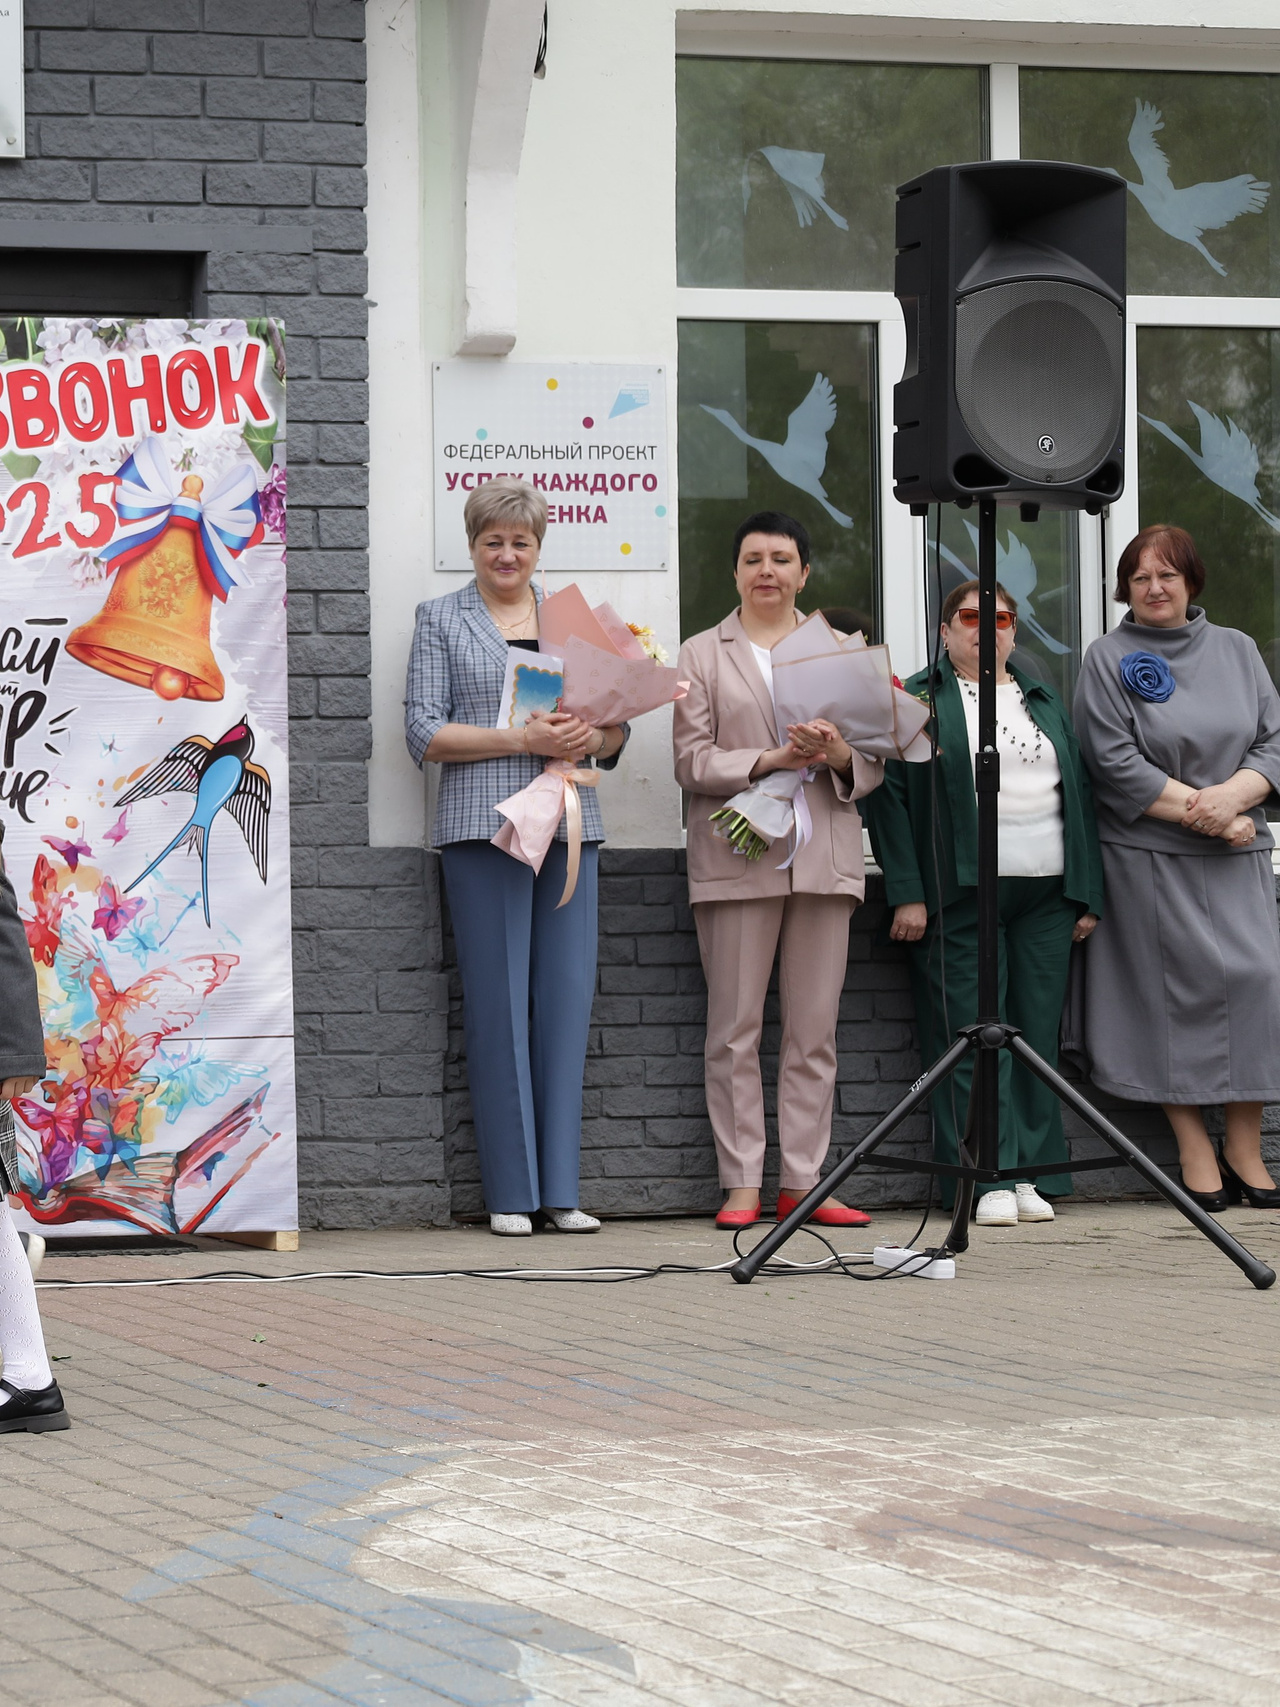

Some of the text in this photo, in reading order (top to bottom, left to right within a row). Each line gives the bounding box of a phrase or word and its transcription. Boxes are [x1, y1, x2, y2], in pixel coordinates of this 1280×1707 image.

[443, 442, 658, 462] ФЕДЕРАЛЬНЫЙ ПРОЕКТ
[532, 473, 658, 496] КАЖДОГО
